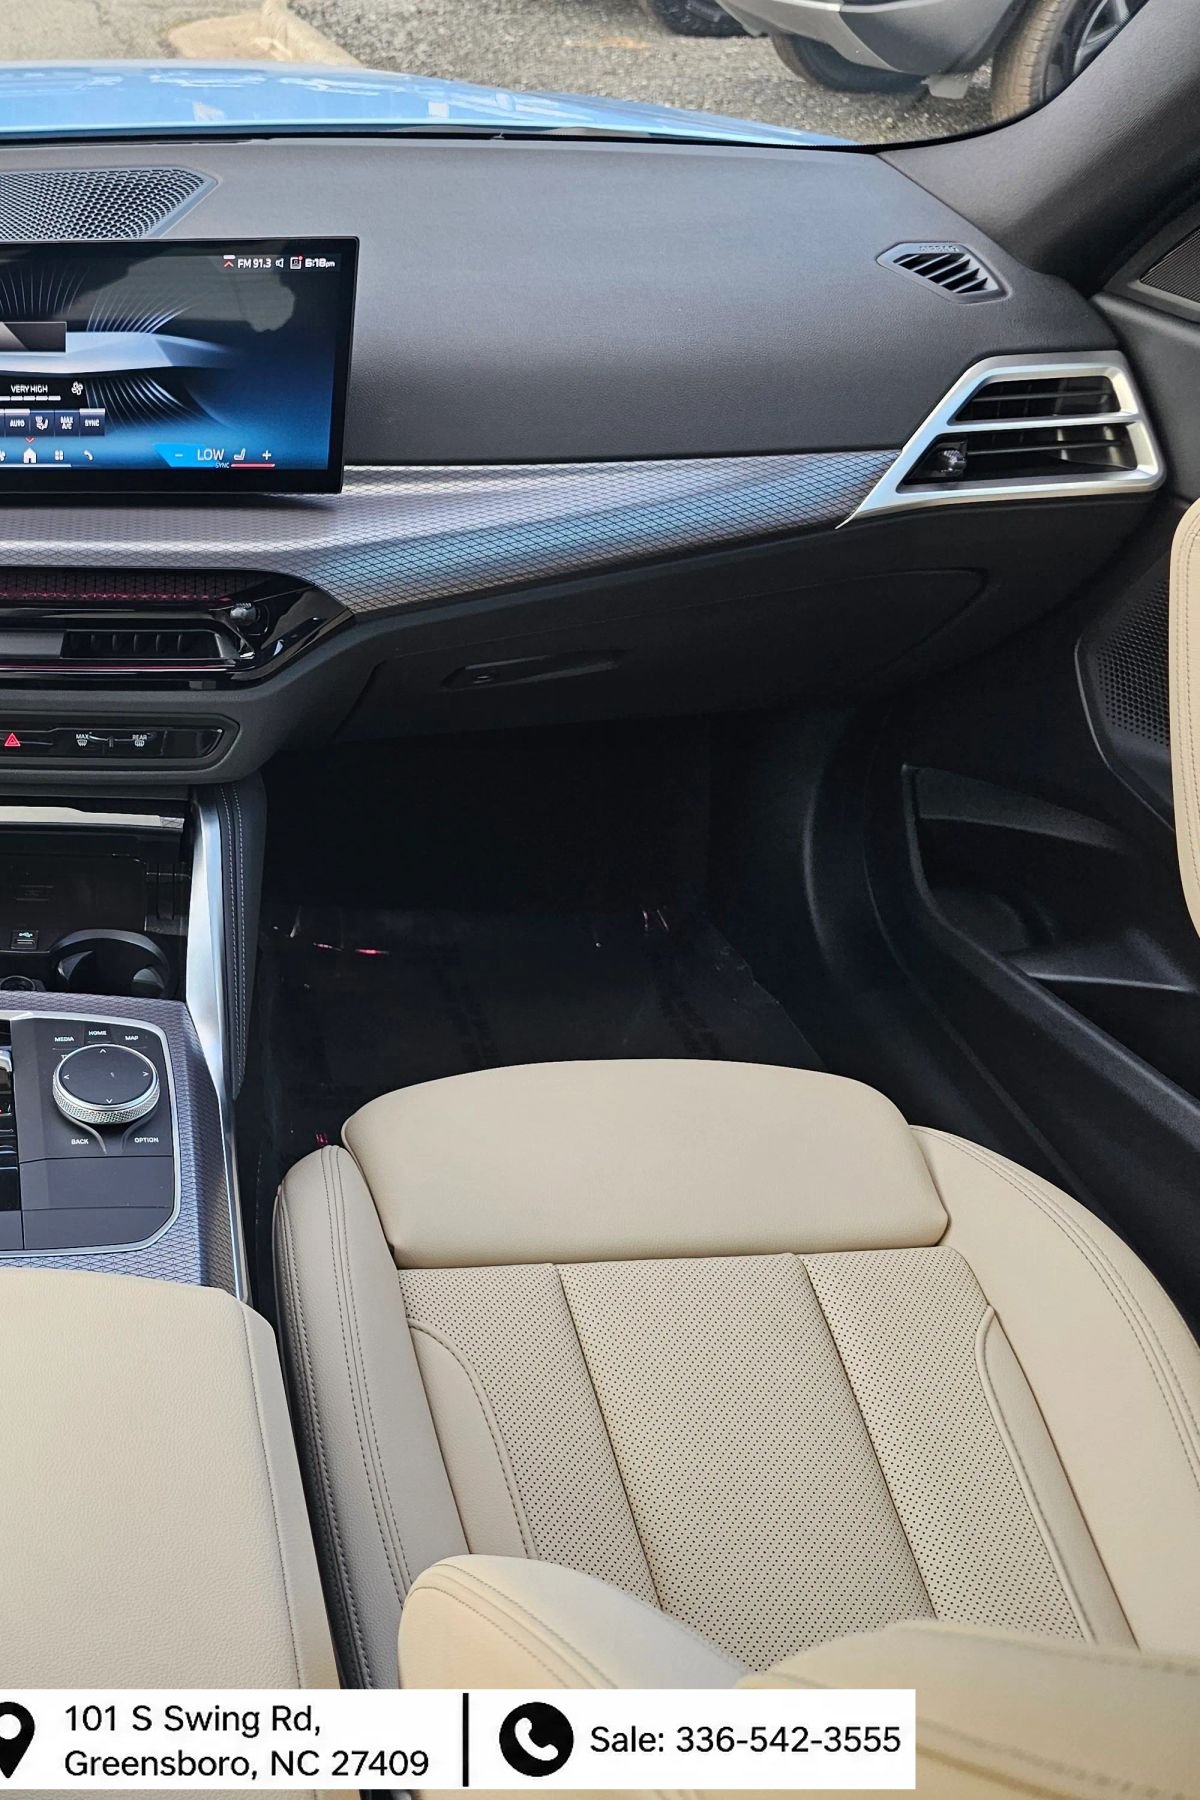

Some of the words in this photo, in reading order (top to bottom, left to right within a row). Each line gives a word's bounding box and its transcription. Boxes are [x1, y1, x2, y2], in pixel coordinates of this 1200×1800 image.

[237, 258, 252, 268] FM
[252, 258, 271, 268] 91.3
[10, 384, 30, 394] VERY
[30, 384, 48, 394] HIGH
[9, 419, 25, 428] AUTO
[196, 448, 225, 461] LOW
